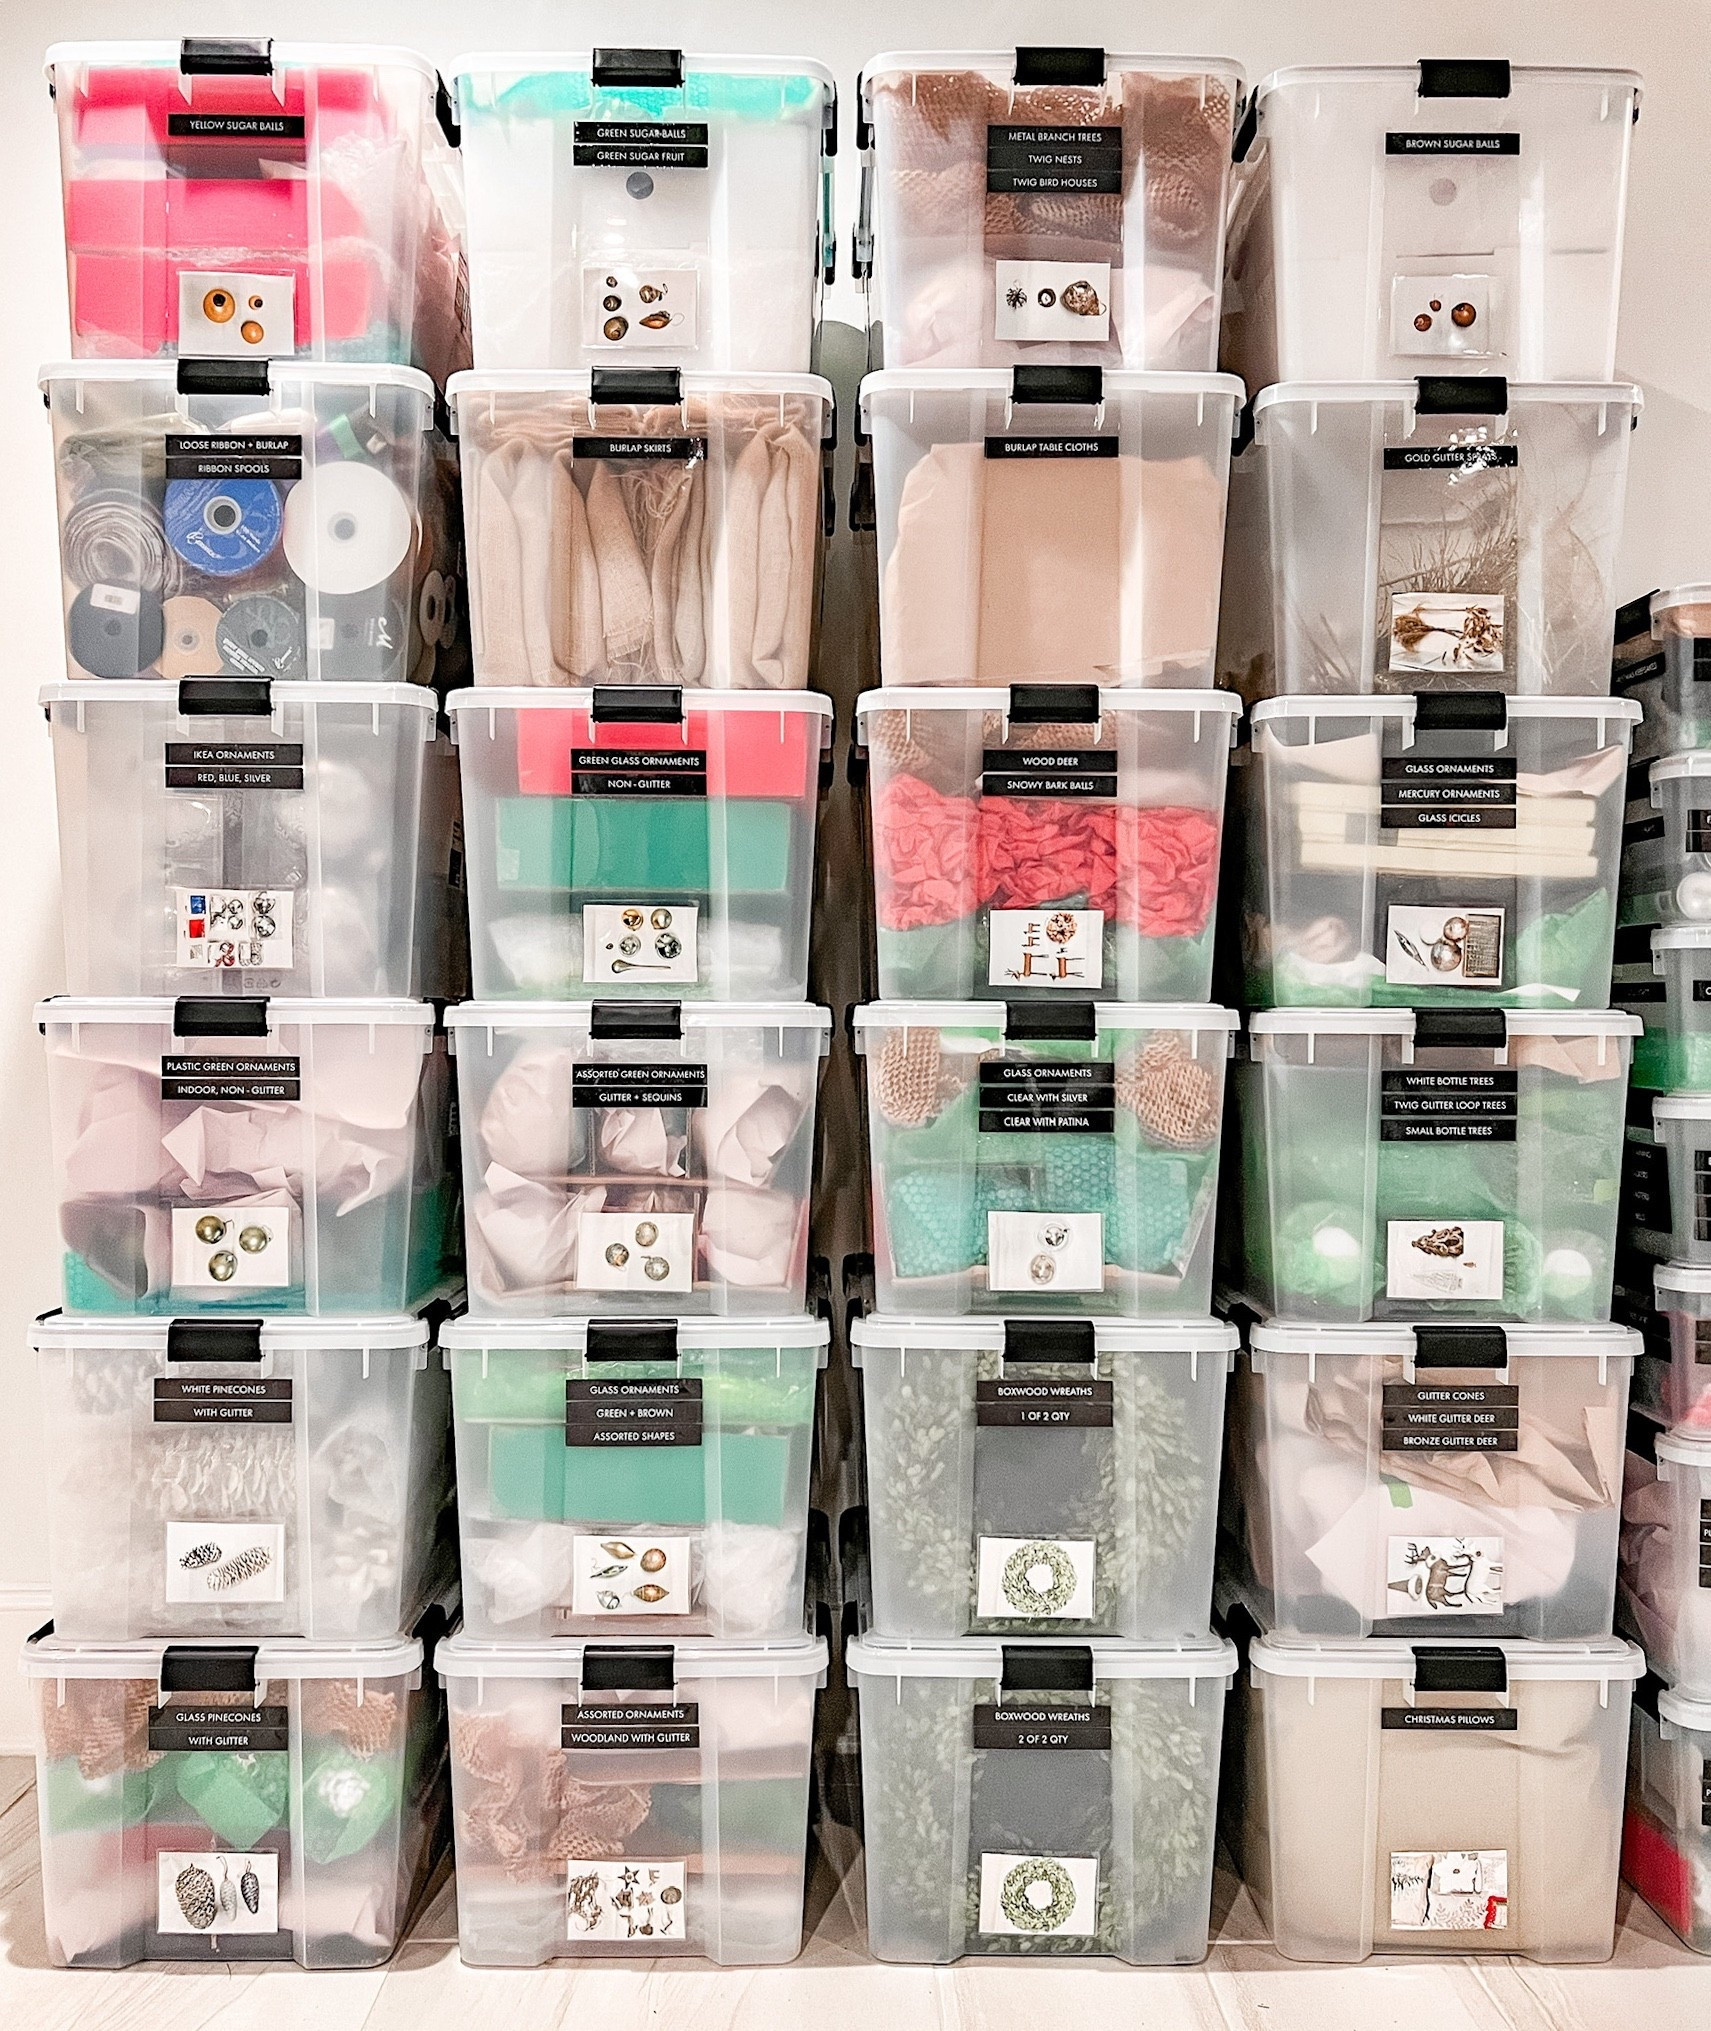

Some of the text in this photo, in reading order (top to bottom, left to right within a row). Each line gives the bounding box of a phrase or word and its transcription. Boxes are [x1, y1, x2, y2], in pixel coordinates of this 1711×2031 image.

[189, 120, 284, 131] YELLOW SUGAR BALLS
[596, 128, 628, 138] GREEN
[1008, 131, 1102, 143] METAL BRANCH TREES
[1405, 139, 1500, 149] BROWN SUGAR BALLS
[596, 151, 685, 162] GREEN SUGAR FRUIT
[1028, 154, 1083, 165] TWIG NESTS
[1012, 177, 1098, 188] TWIG BIRD HOUSES
[179, 440, 210, 450] LOOSE
[210, 440, 246, 450] RIBBON
[255, 440, 289, 450] BURLAP
[609, 443, 673, 453] BURLAP SKIRTS
[1004, 442, 1099, 452] BURLAP TABLE CLOTHS
[1404, 453, 1431, 463] GOLD
[1432, 452, 1466, 463] GLITTER
[198, 464, 270, 474] RIBBON SPOOLS
[193, 750, 276, 760] IKEA ORNAMENTS
[578, 756, 700, 767] GREEN GLASS ORNAMENTS
[1022, 756, 1079, 766] WOOD DEER
[1404, 764, 1495, 774] GLASS ORNAMENTS
[197, 773, 271, 784] RED, BLUE, SILVER
[1007, 780, 1094, 791] SNOWY BARK BALLS
[1398, 789, 1501, 799] MERCURY ORNAMENTS
[1417, 813, 1481, 823] GLASS ICICLES
[166, 1061, 295, 1072] PLASTIC GREEN ORNAMENTS
[575, 1069, 706, 1079] ASSORTED GREEN ORNAMENTS
[1003, 1068, 1092, 1078] GLASS ORNAMENTS
[1406, 1076, 1495, 1086] WHITE BOTTLE TREES
[177, 1085, 219, 1096] INDOOR,
[220, 1085, 245, 1095] NON
[250, 1085, 285, 1095] GLITTER
[598, 1092, 632, 1102] GLITTER
[642, 1092, 683, 1102] SEQUINS
[1006, 1093, 1088, 1103] CLEAR WITH SILVER
[1394, 1100, 1507, 1110] TWIG GLITTER LOOP TREES
[1003, 1116, 1090, 1127] CLEAR WITH PATINA
[1405, 1126, 1493, 1136] SMALL BOTTLE TREES
[181, 1384, 267, 1395] WHITE PINECONES
[589, 1384, 680, 1395] GLASS ORNAMENTS
[997, 1386, 1093, 1397] BOXWOOD WREATHS
[1417, 1391, 1486, 1401] GLITTER CONES
[193, 1408, 254, 1418] WITH GLITTER
[595, 1408, 628, 1419] GREEN
[637, 1408, 674, 1418] BROWN
[1021, 1411, 1071, 1421] 1 OF 2 QTY
[1407, 1413, 1496, 1424] WHITE GLITTER DEER
[592, 1431, 676, 1442] ASSORTED SHAPES
[1403, 1436, 1498, 1446] BRONZE GLITTER DEER
[175, 1712, 262, 1723] GLASS PINECONES
[576, 1709, 685, 1720] ASSORTED ORNAMENTS
[994, 1712, 1091, 1722] BOXWOOD WREATHS
[1404, 1714, 1495, 1725] CHRISTMAS PILLOWS
[188, 1735, 249, 1746] WITH GLITTER
[570, 1732, 691, 1744] WOODLAND WITH GLITTER
[1018, 1734, 1069, 1745] 2 OF 2 QTY
